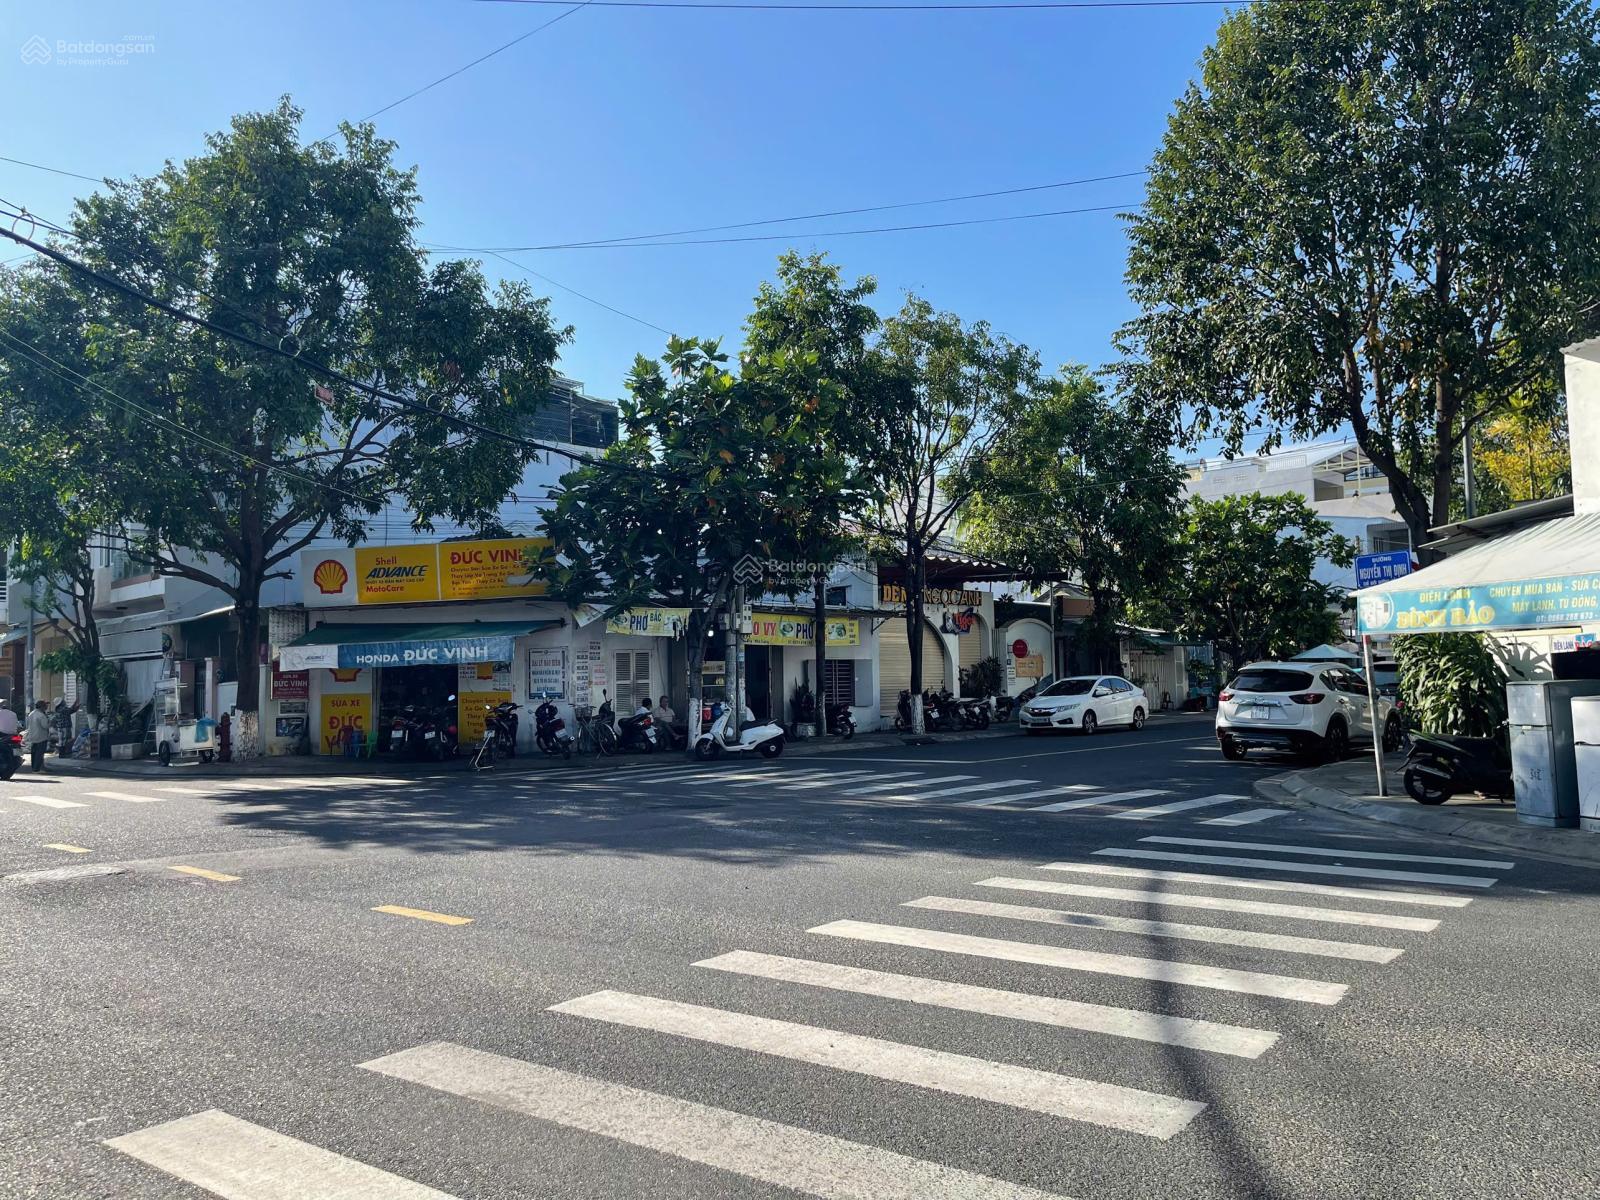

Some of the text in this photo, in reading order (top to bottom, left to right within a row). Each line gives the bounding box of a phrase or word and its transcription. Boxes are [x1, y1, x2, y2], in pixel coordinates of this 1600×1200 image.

[375, 555, 397, 566] Shell
[450, 548, 482, 565] ĐỨC
[366, 564, 429, 579] ADVANCE
[1359, 563, 1408, 580] NGUYỄN THỊ ĐỊNH
[366, 585, 405, 593] MotoCare
[1524, 584, 1543, 596] MUA
[630, 611, 649, 631] PHỞ
[1451, 600, 1496, 626] BẢO
[356, 645, 488, 664] HONDA ĐỨC VINH
[290, 680, 308, 688] VINH
[350, 699, 361, 708] XE
[328, 711, 363, 731] ĐỨC
